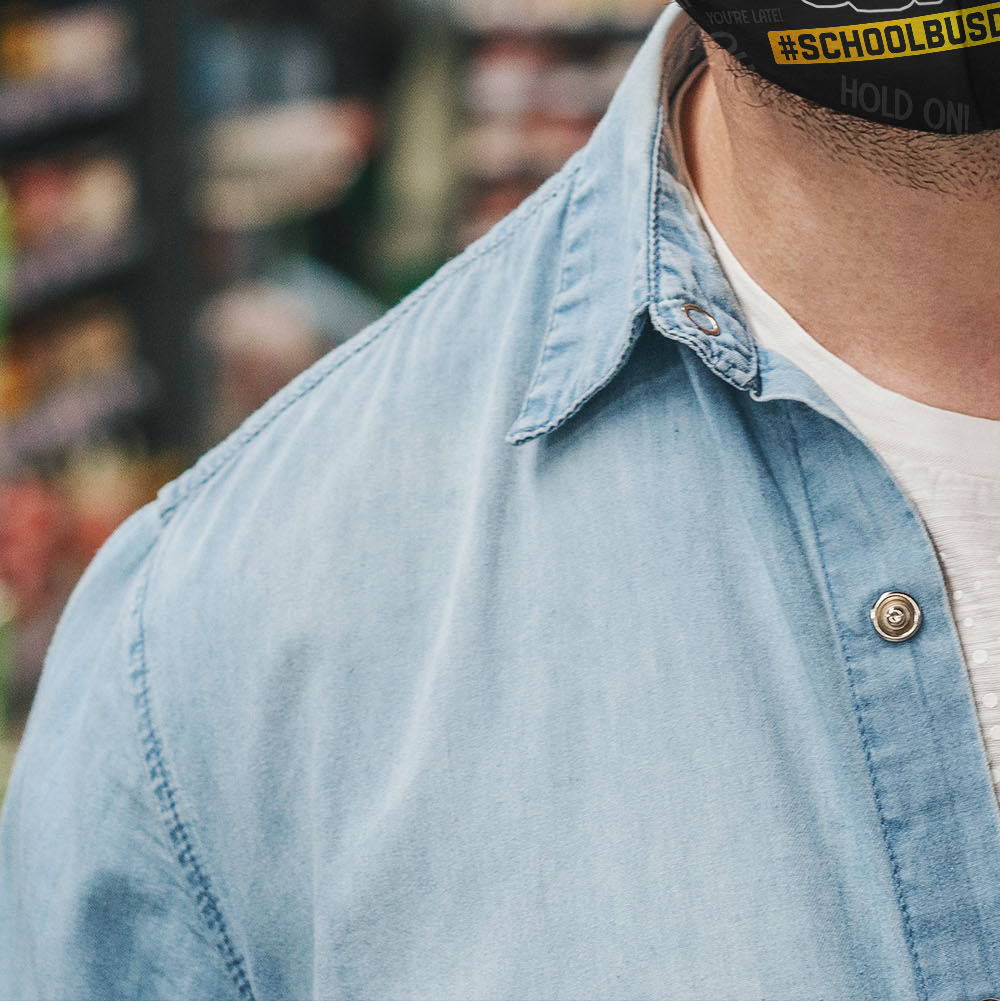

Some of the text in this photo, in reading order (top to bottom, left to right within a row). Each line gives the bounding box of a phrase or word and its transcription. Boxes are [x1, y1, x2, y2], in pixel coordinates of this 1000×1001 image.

[704, 7, 784, 25] YOU'RE LATE!
[840, 74, 971, 133] HOLD ON!
